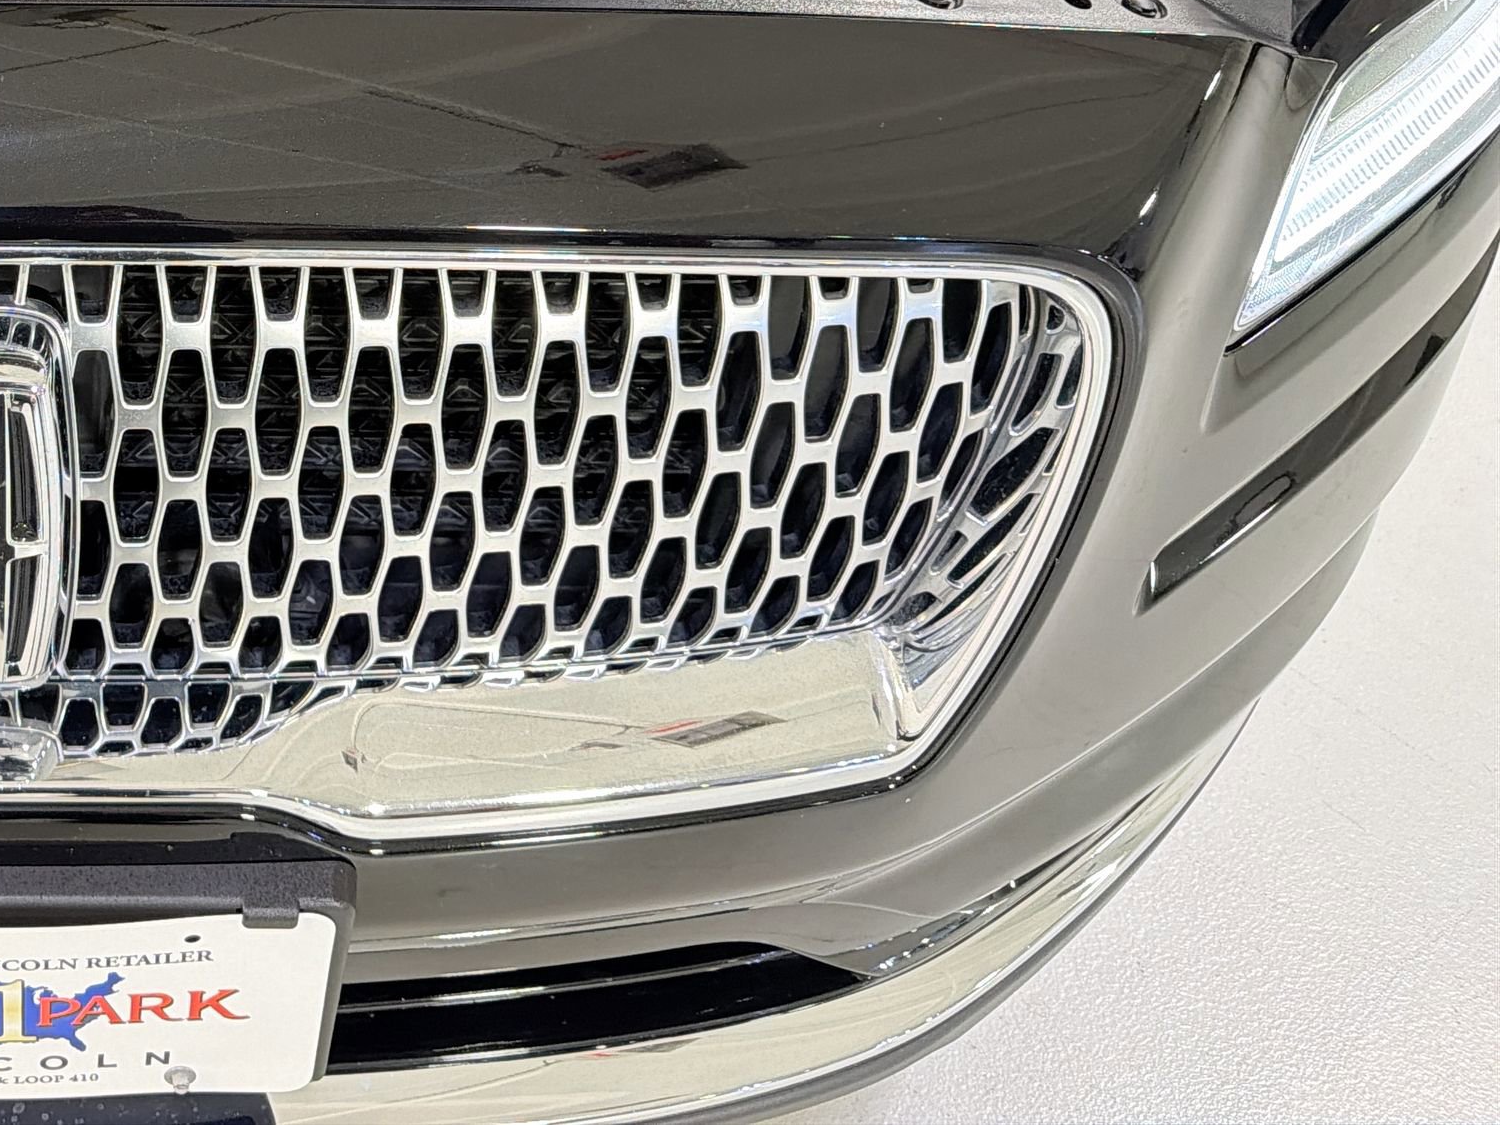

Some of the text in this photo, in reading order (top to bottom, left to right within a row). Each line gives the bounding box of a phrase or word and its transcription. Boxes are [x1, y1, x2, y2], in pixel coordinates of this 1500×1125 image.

[85, 949, 214, 969] RETAILER
[36, 988, 252, 1027] PARK
[14, 1074, 65, 1084] LOOP
[68, 1072, 100, 1083] 410
